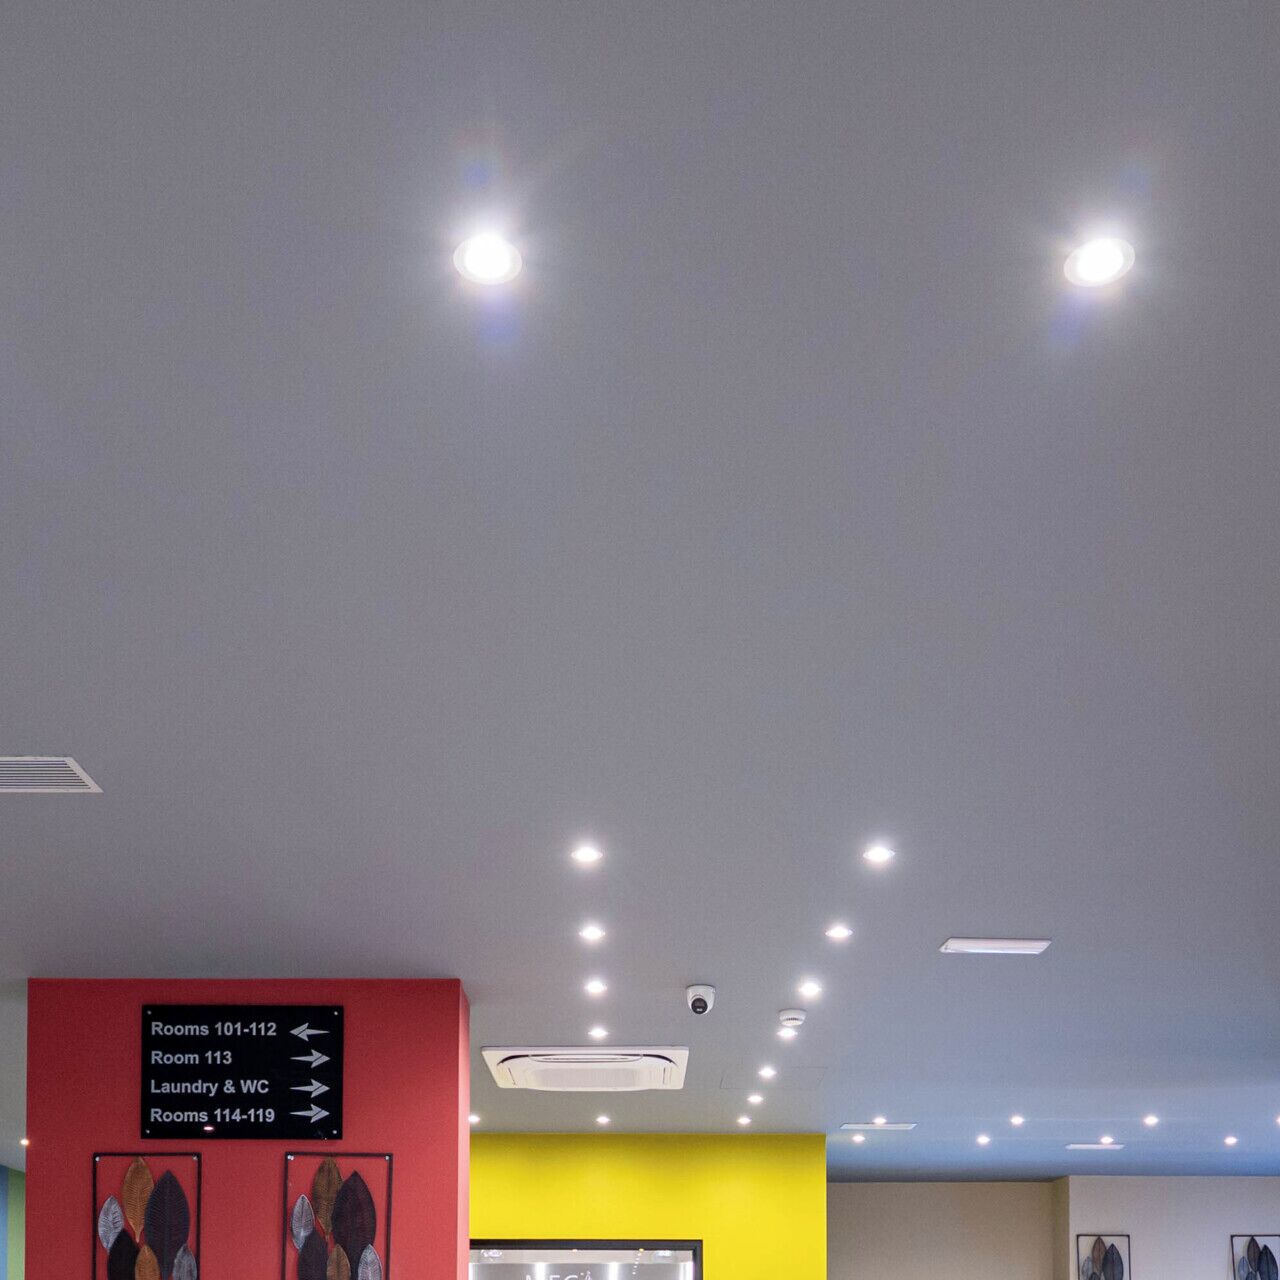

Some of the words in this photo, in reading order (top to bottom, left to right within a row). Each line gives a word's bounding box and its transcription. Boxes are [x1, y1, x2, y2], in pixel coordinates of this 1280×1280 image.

[150, 1021, 210, 1036] Rooms
[214, 1021, 277, 1036] 101-112
[150, 1050, 200, 1065] Room
[204, 1050, 233, 1065] 113
[150, 1079, 218, 1097] Laundry
[223, 1079, 236, 1094] &
[240, 1079, 270, 1094] WC
[150, 1108, 209, 1123] Rooms
[213, 1108, 276, 1123] 114-119
